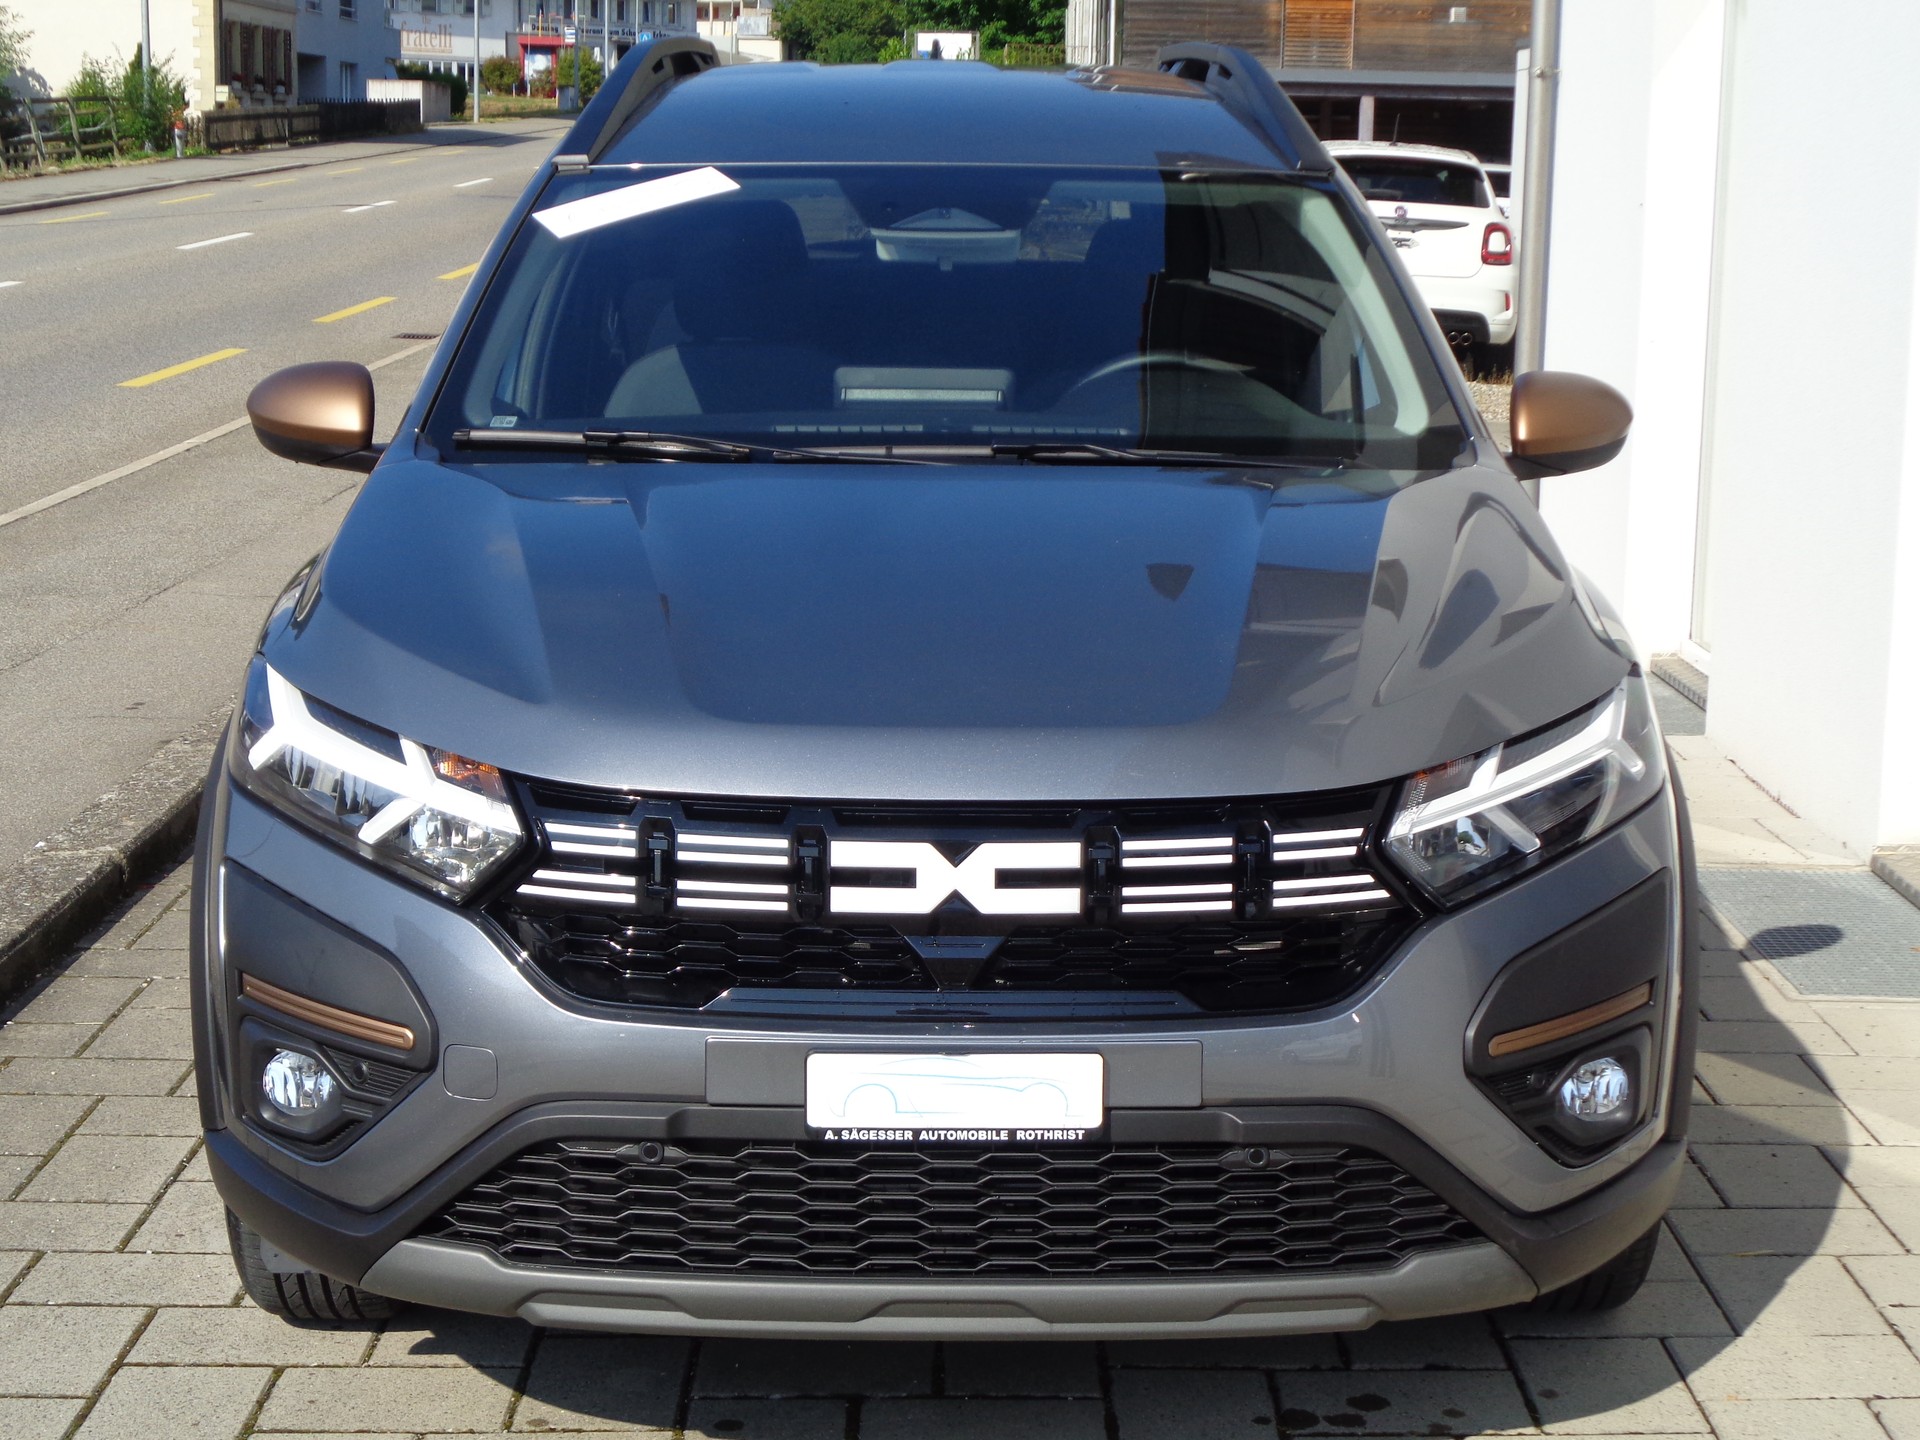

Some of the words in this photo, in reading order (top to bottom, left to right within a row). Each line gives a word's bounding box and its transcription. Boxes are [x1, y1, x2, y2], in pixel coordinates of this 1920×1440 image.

[401, 20, 452, 48] fratelli
[824, 1129, 839, 1140] A.
[841, 1128, 914, 1141] SÄGESSER
[918, 1129, 1009, 1141] AUTOMOBILE
[1015, 1128, 1086, 1141] ROTHRIST
